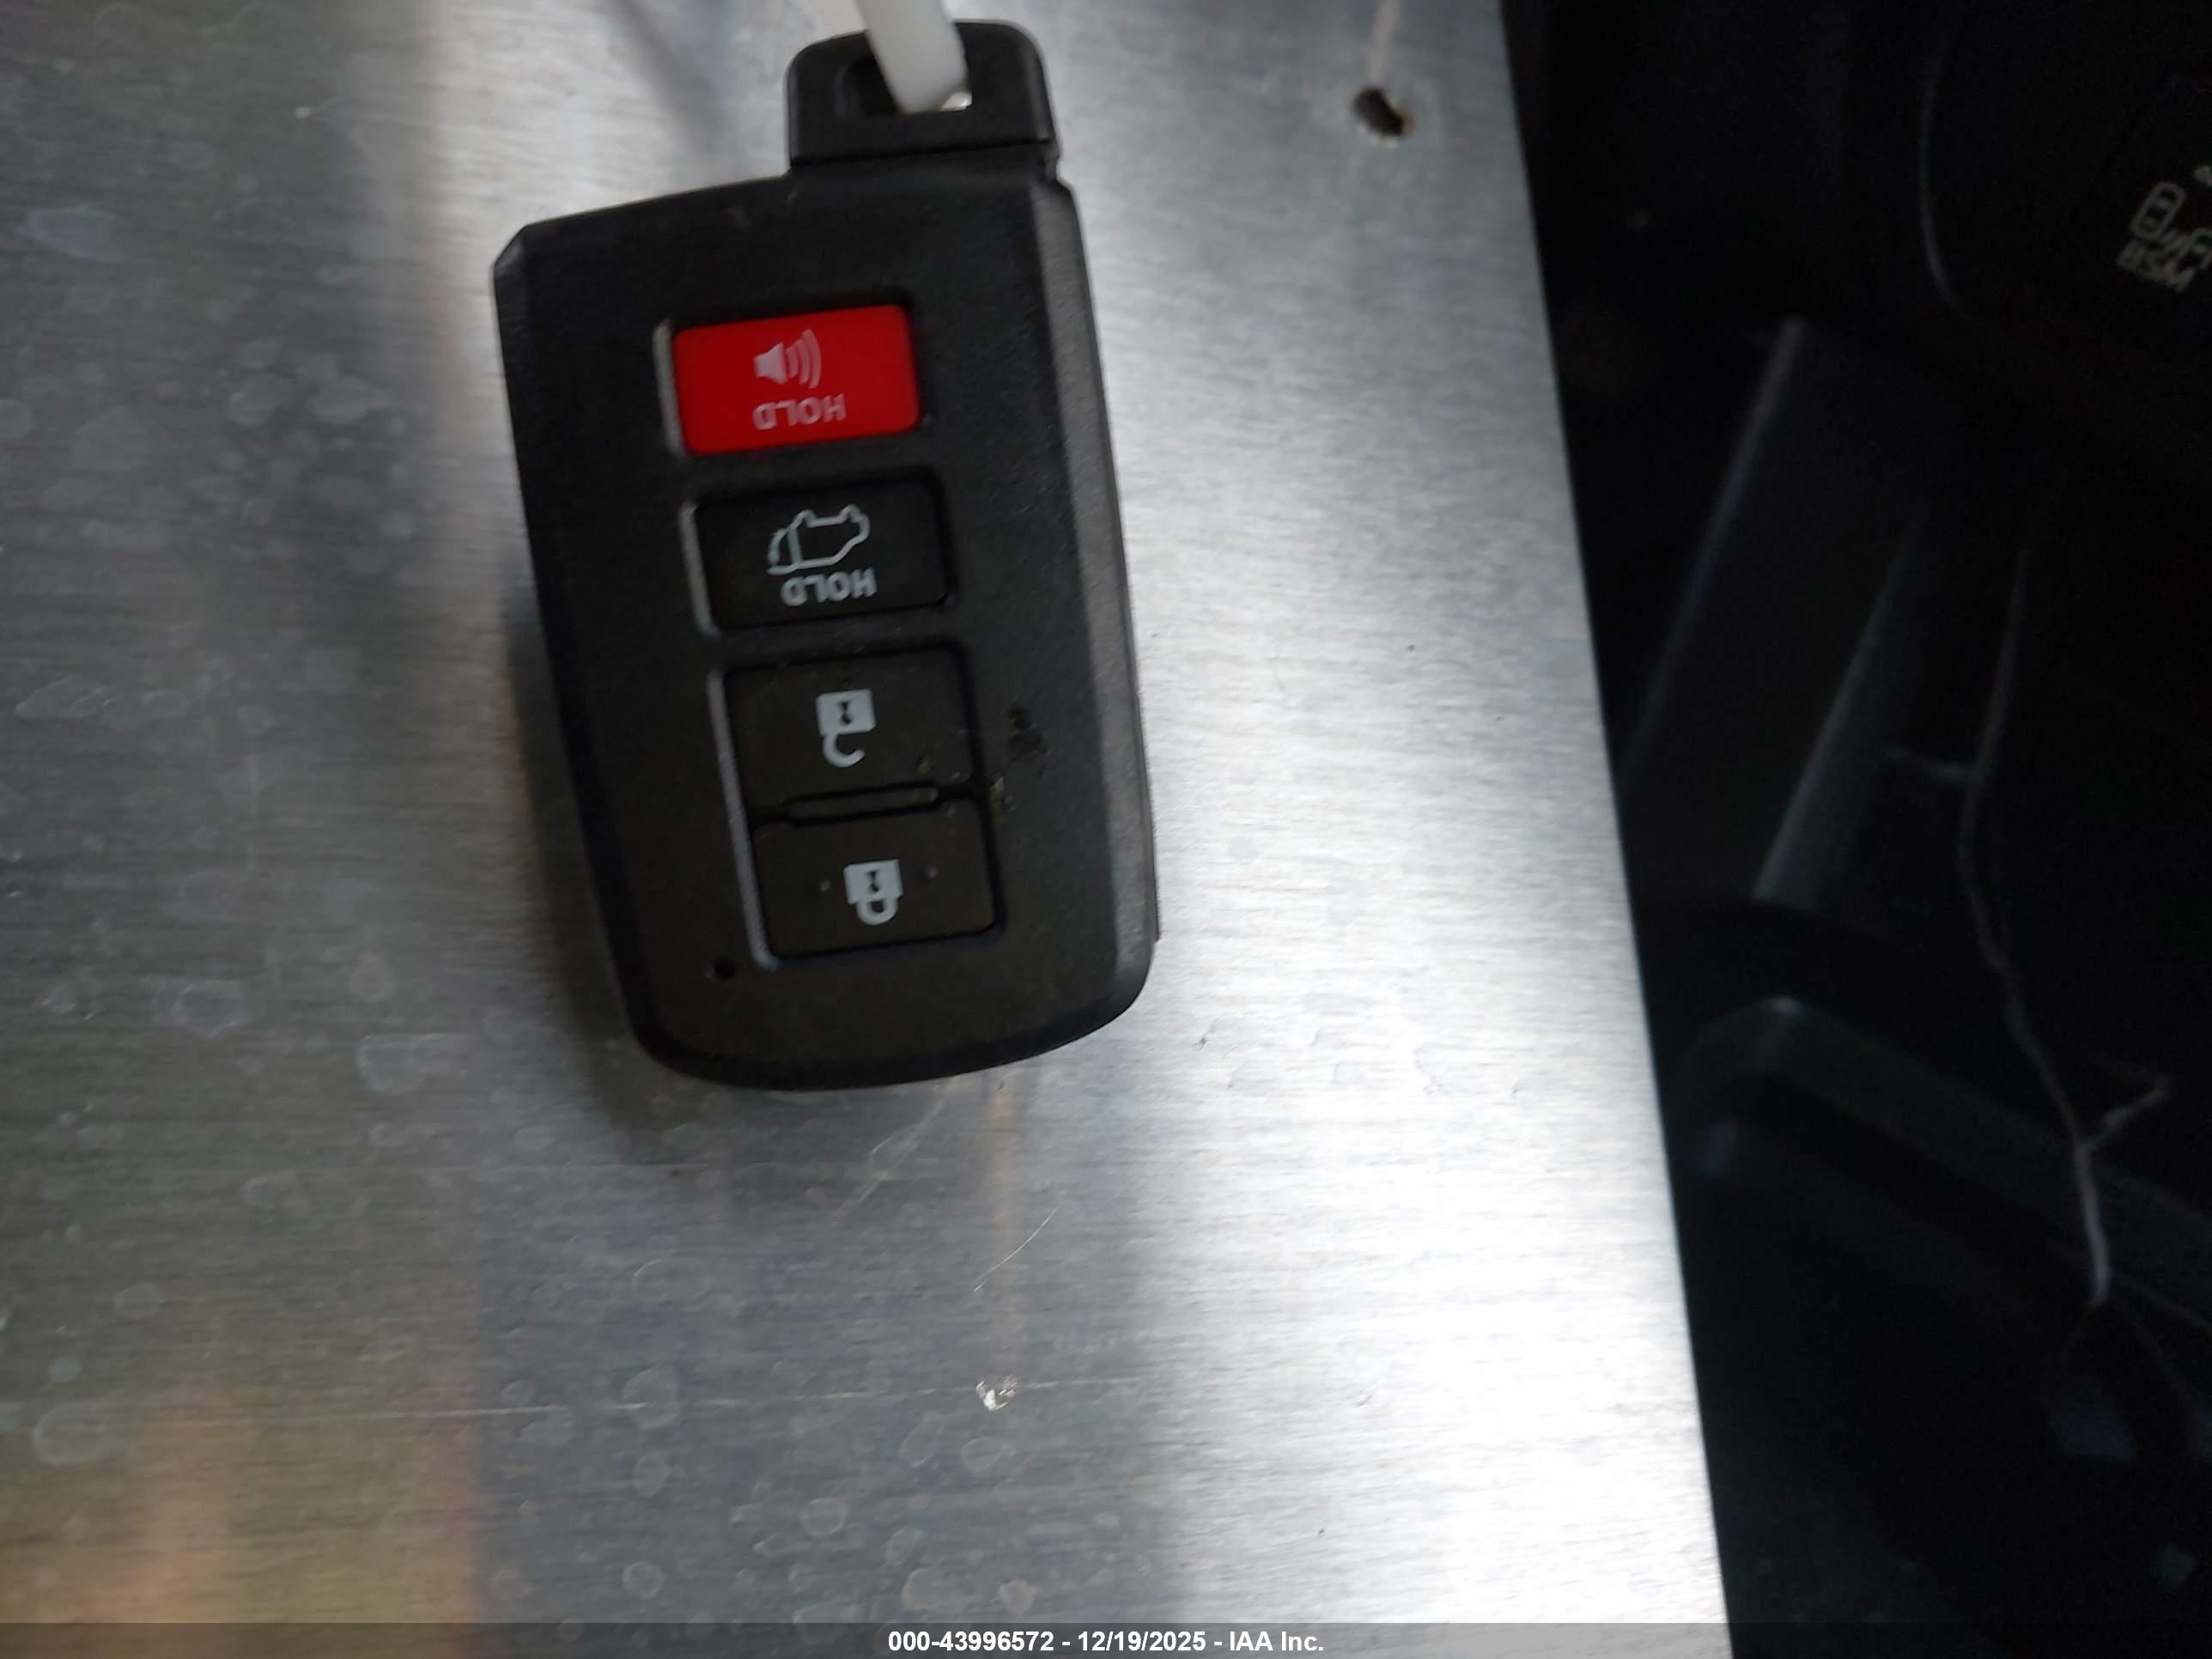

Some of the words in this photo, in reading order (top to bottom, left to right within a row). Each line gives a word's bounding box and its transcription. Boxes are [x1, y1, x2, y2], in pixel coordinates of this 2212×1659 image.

[2117, 238, 2195, 292] BSM
[753, 393, 846, 429] HOLD
[781, 568, 877, 605] HOLD
